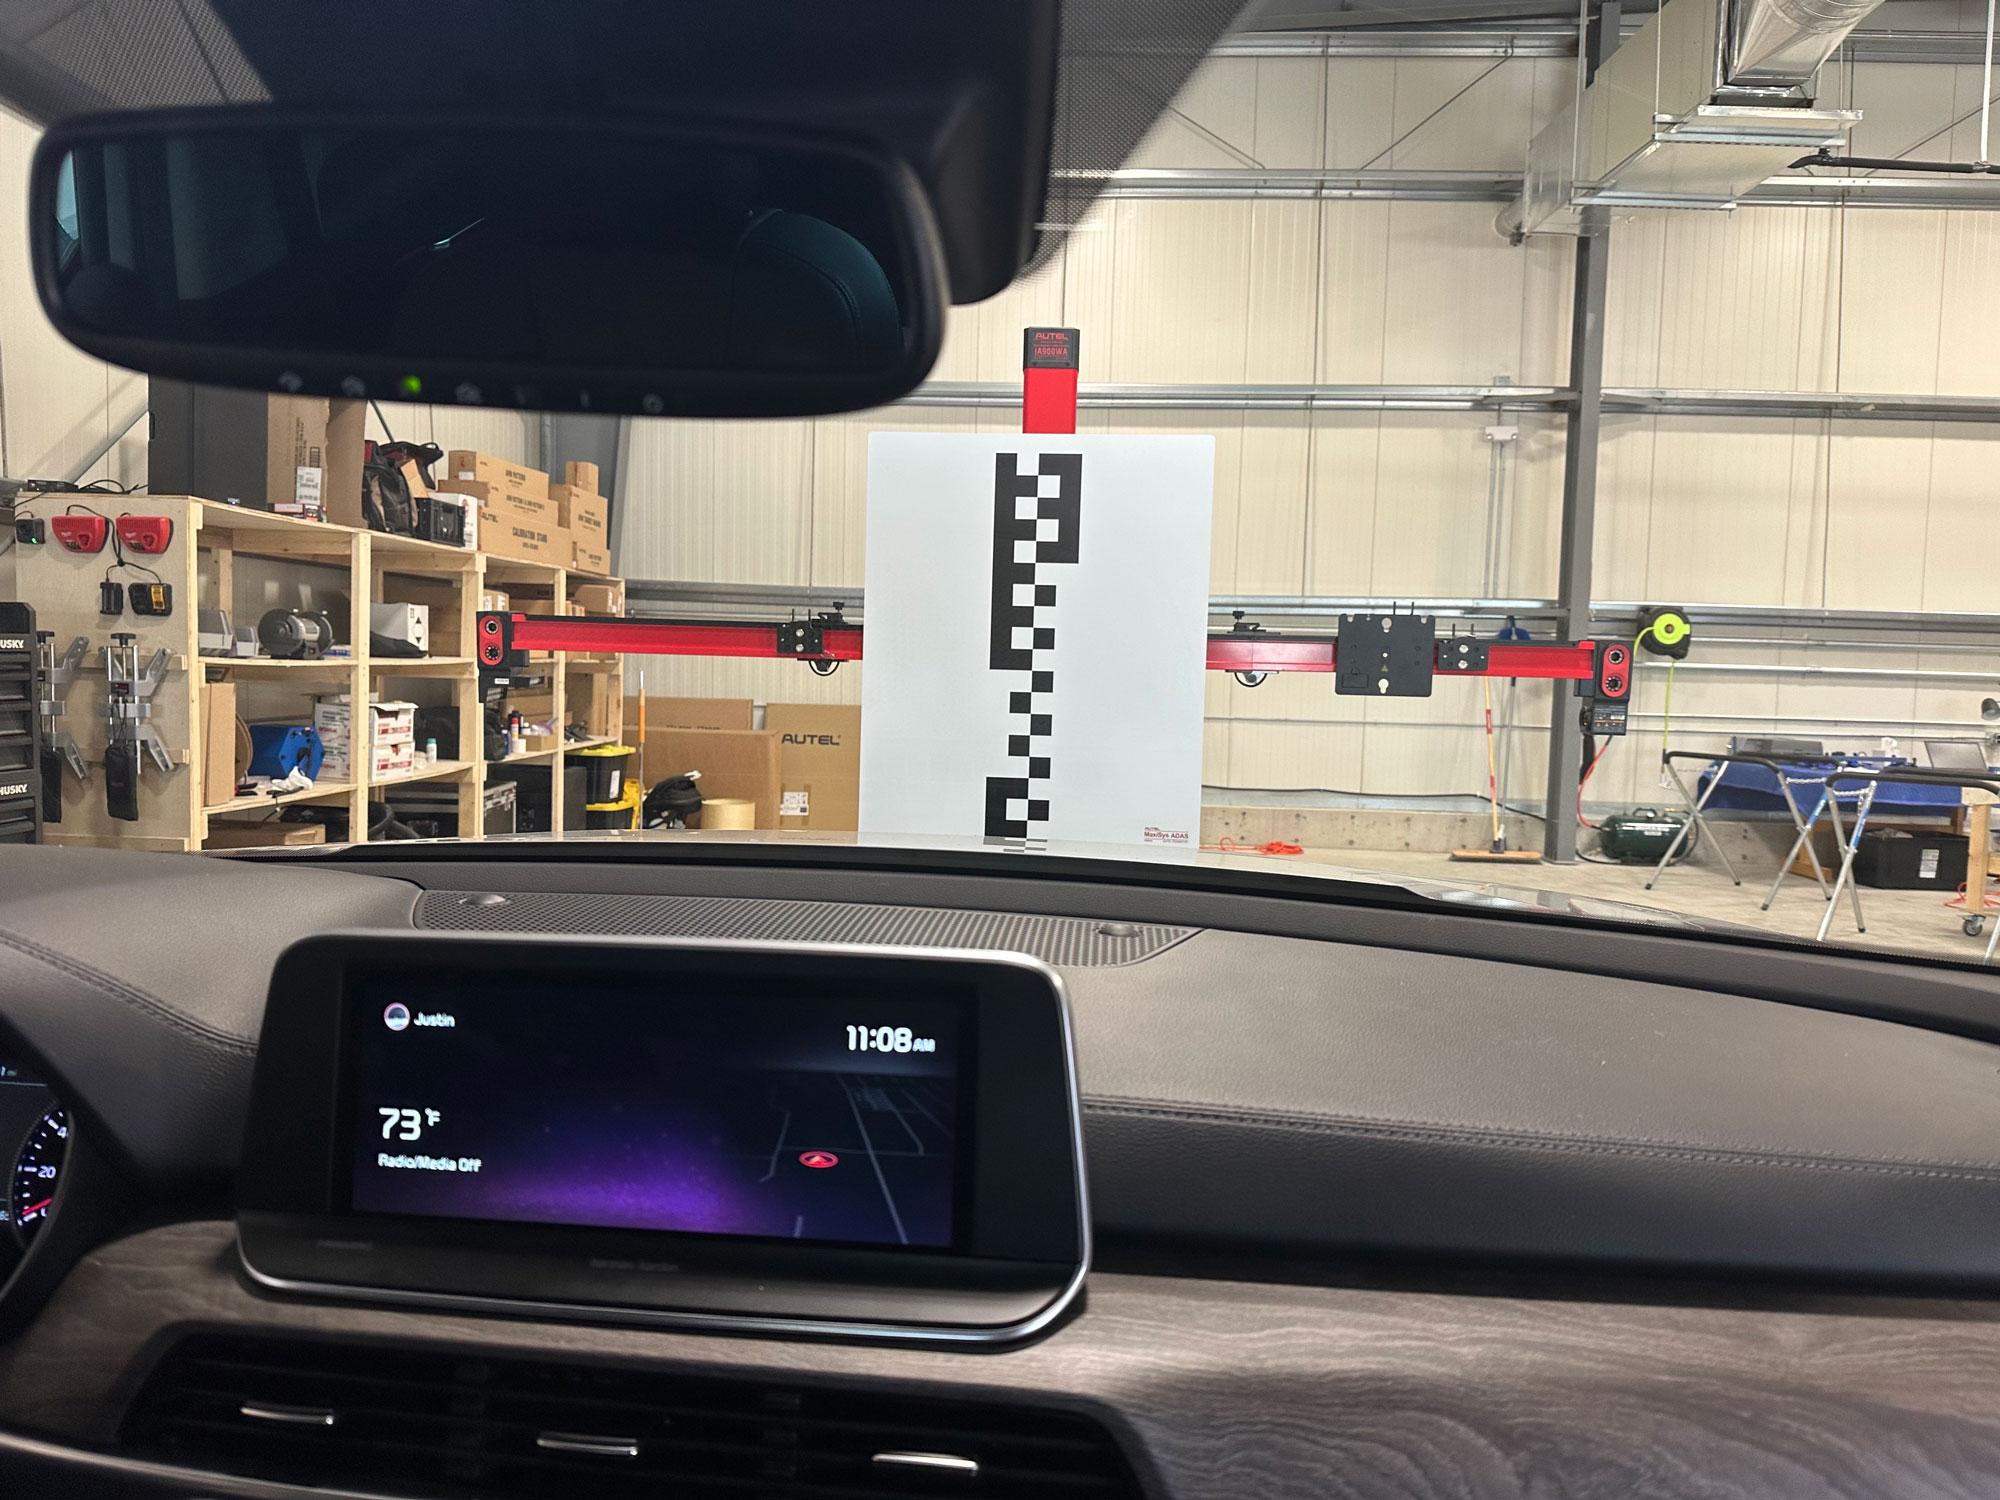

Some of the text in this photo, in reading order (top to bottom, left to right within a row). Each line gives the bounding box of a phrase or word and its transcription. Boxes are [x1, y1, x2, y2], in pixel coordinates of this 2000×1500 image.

[1035, 332, 1069, 341] AUTEL
[0, 639, 25, 649] USKY
[781, 733, 841, 746] AUTEL
[1143, 831, 1189, 840] MaxiSys ADAS
[413, 1011, 456, 1028] Justin
[377, 1153, 482, 1173] Radio/Media Off
[37, 1165, 57, 1179] 20
